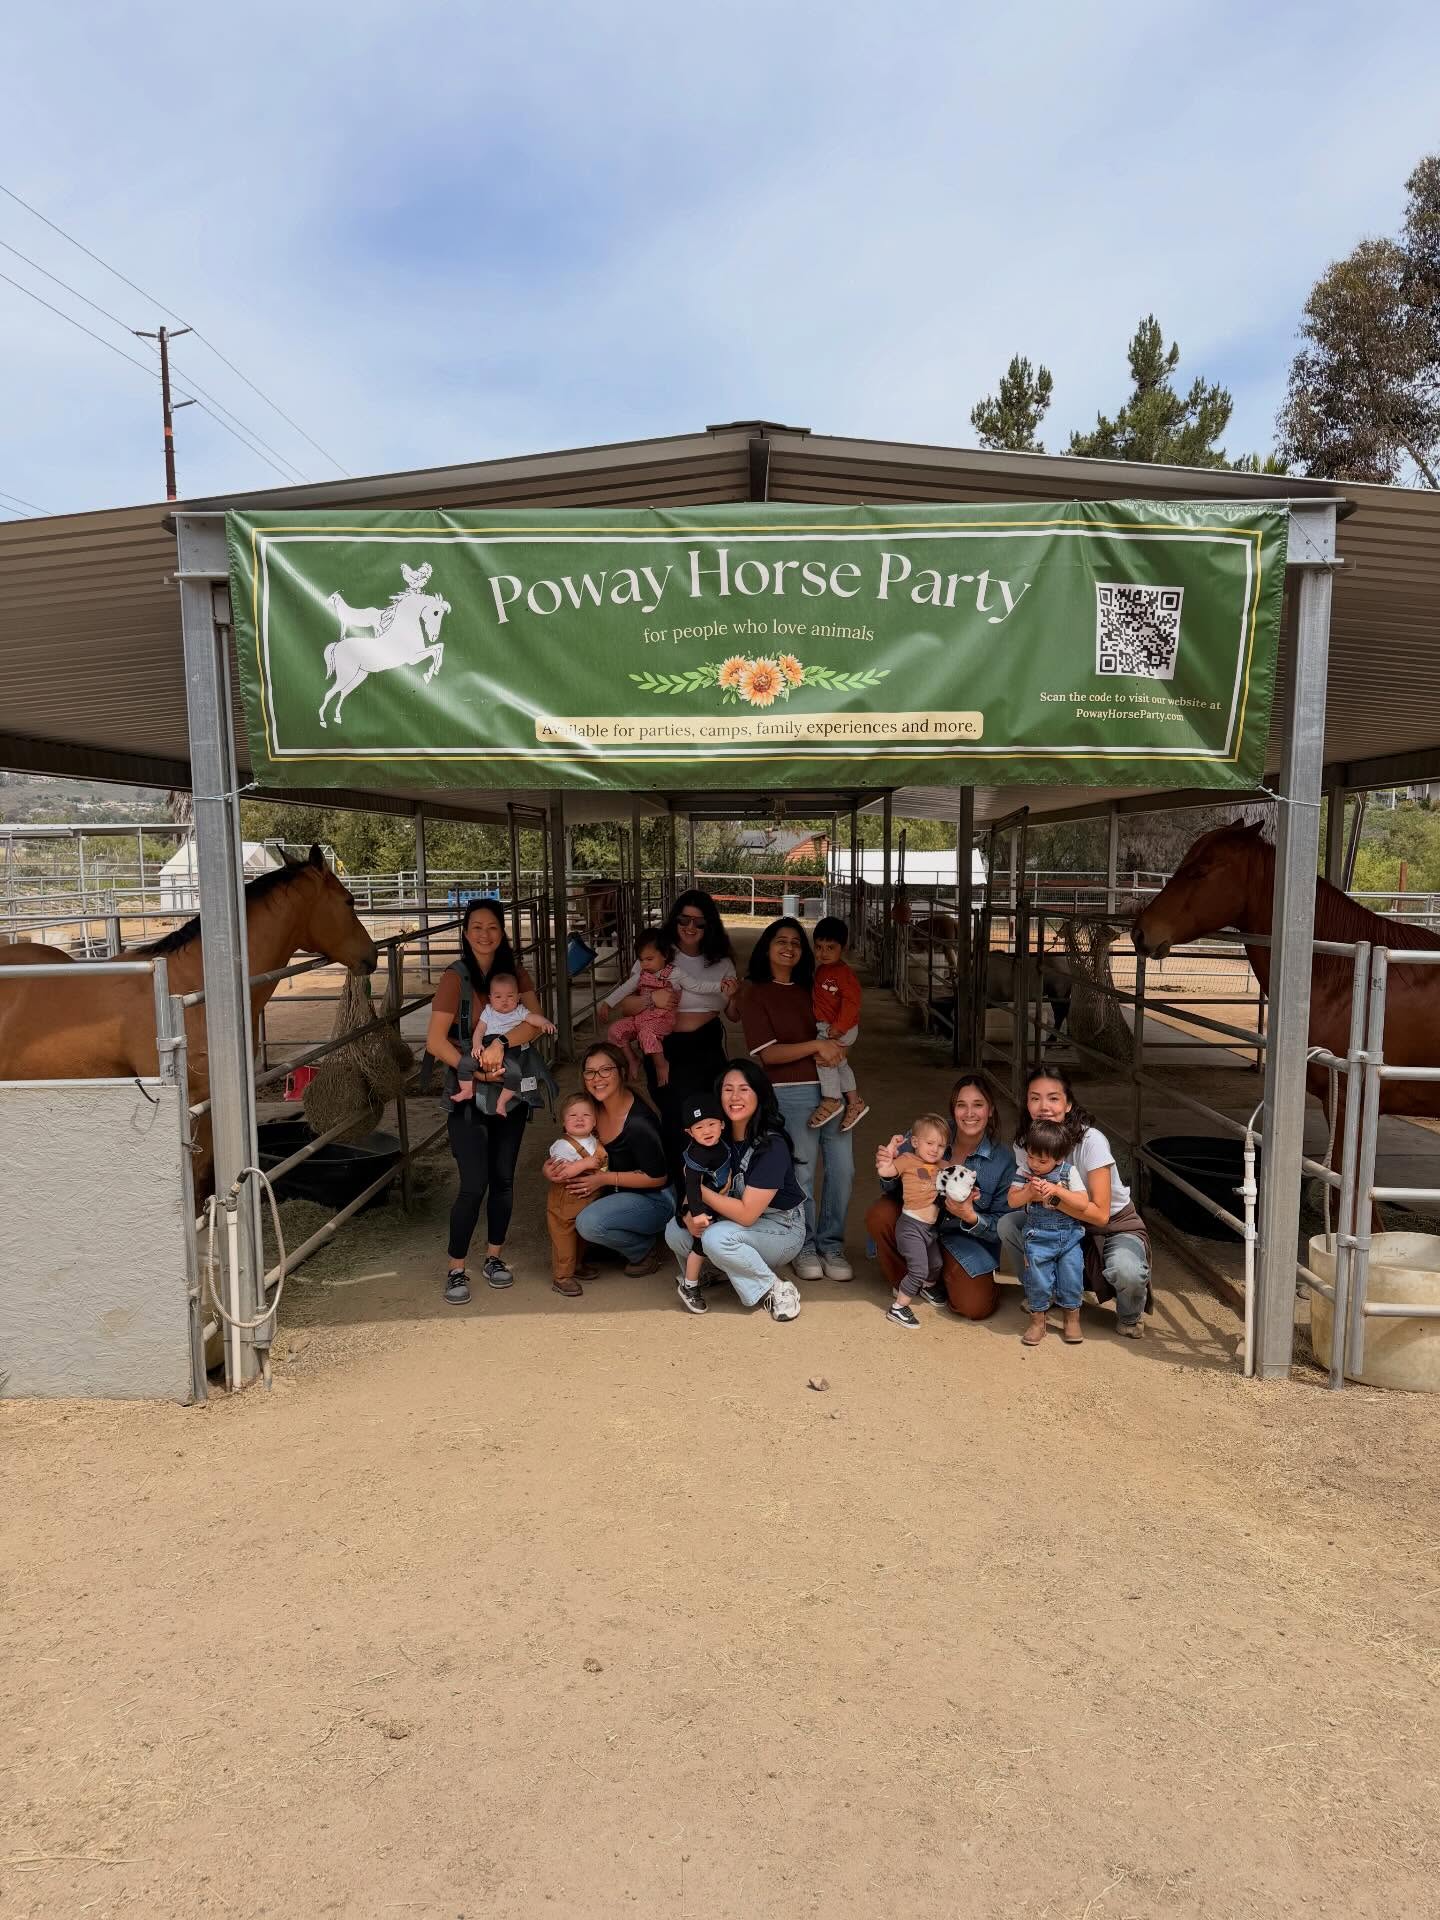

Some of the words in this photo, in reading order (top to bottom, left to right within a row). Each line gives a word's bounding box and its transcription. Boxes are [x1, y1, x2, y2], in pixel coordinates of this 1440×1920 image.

[488, 564, 673, 624] Poway
[688, 548, 861, 598] Horse
[876, 552, 1032, 624] Party
[643, 628, 668, 643] for
[672, 620, 728, 643] people
[732, 618, 769, 637] who
[772, 618, 807, 635] love
[811, 622, 875, 641] animals
[1039, 692, 1066, 702] Scan
[1069, 691, 1087, 702] the
[1089, 692, 1112, 702] code
[1114, 693, 1126, 703] to
[1128, 692, 1150, 703] visit
[1151, 696, 1166, 705] our
[1167, 697, 1207, 708] website
[1209, 702, 1222, 710] at
[1075, 708, 1185, 723] PowayHorseParty.com
[613, 723, 635, 737] for
[639, 723, 695, 740] parties,
[699, 725, 752, 739] camps,
[756, 721, 803, 738] family
[806, 720, 897, 737] experiences
[901, 719, 929, 733] and
[933, 720, 977, 733] more.
